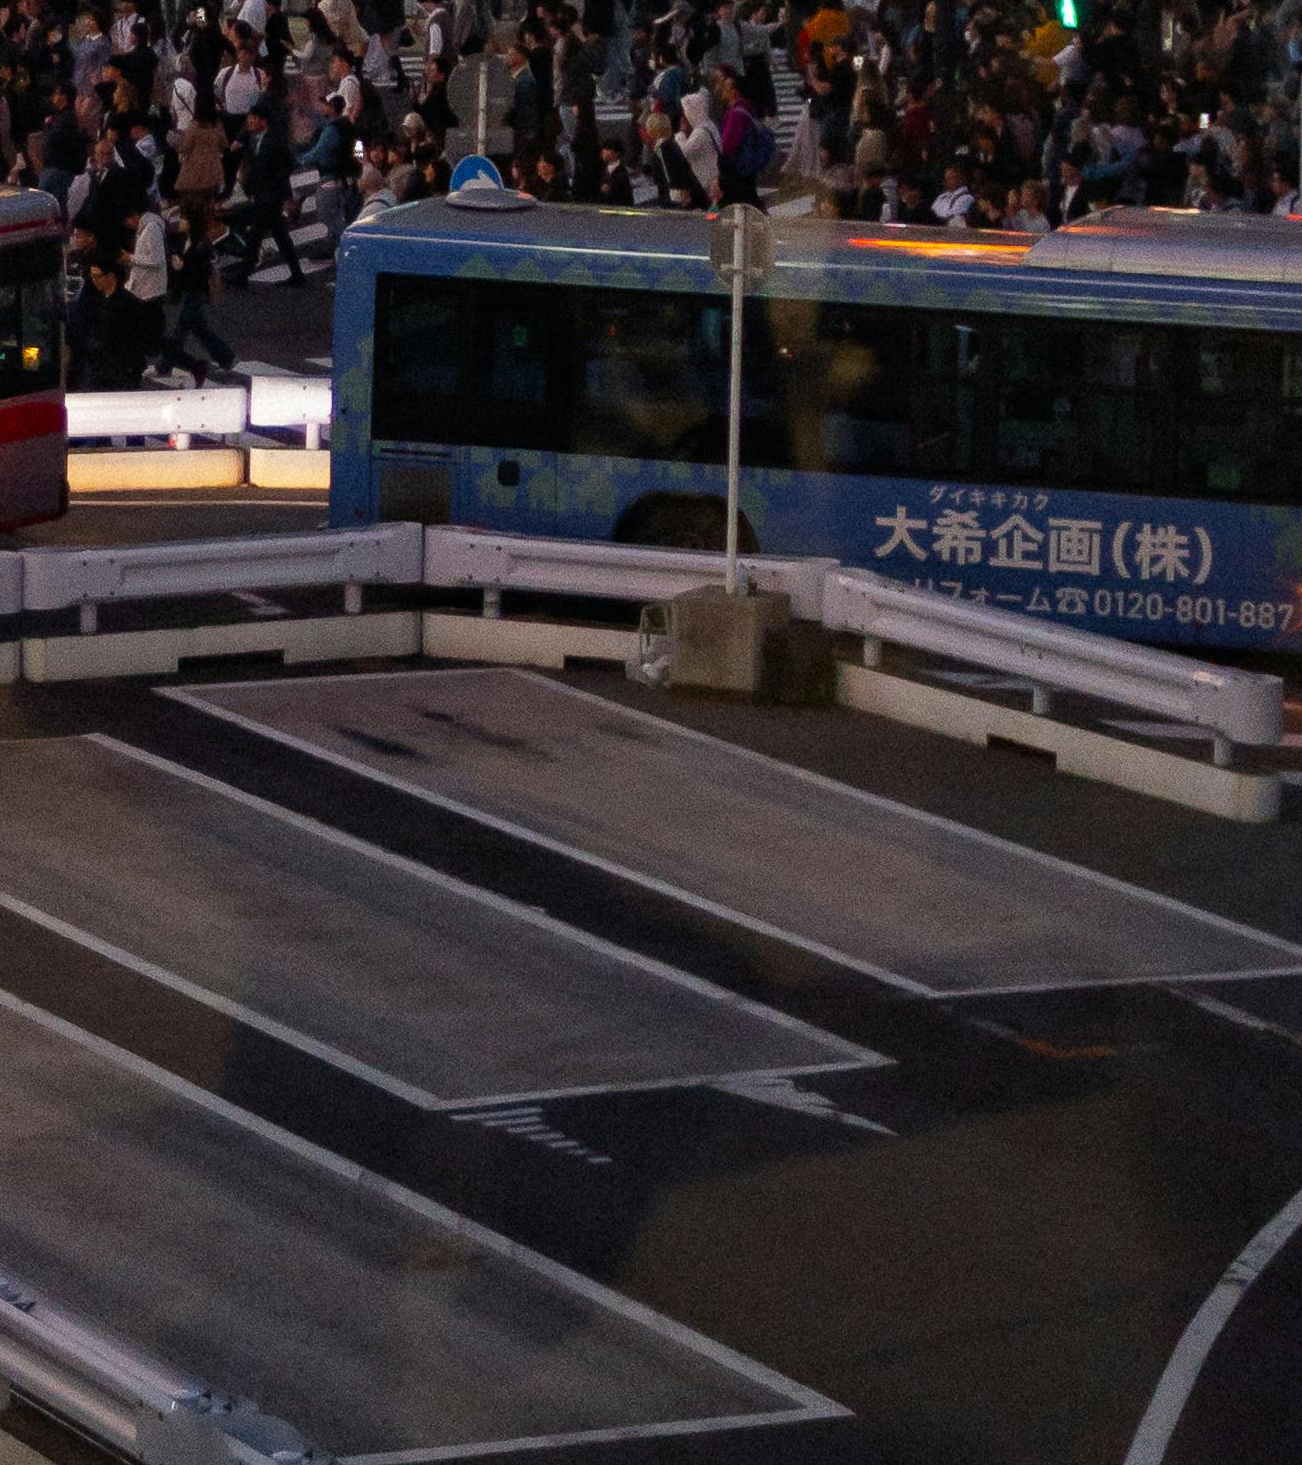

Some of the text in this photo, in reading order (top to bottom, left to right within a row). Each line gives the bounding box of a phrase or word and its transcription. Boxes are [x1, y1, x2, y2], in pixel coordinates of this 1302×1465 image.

[874, 505, 1214, 584] 大希企画(株)
[1093, 589, 1293, 631] 0120-801-887
